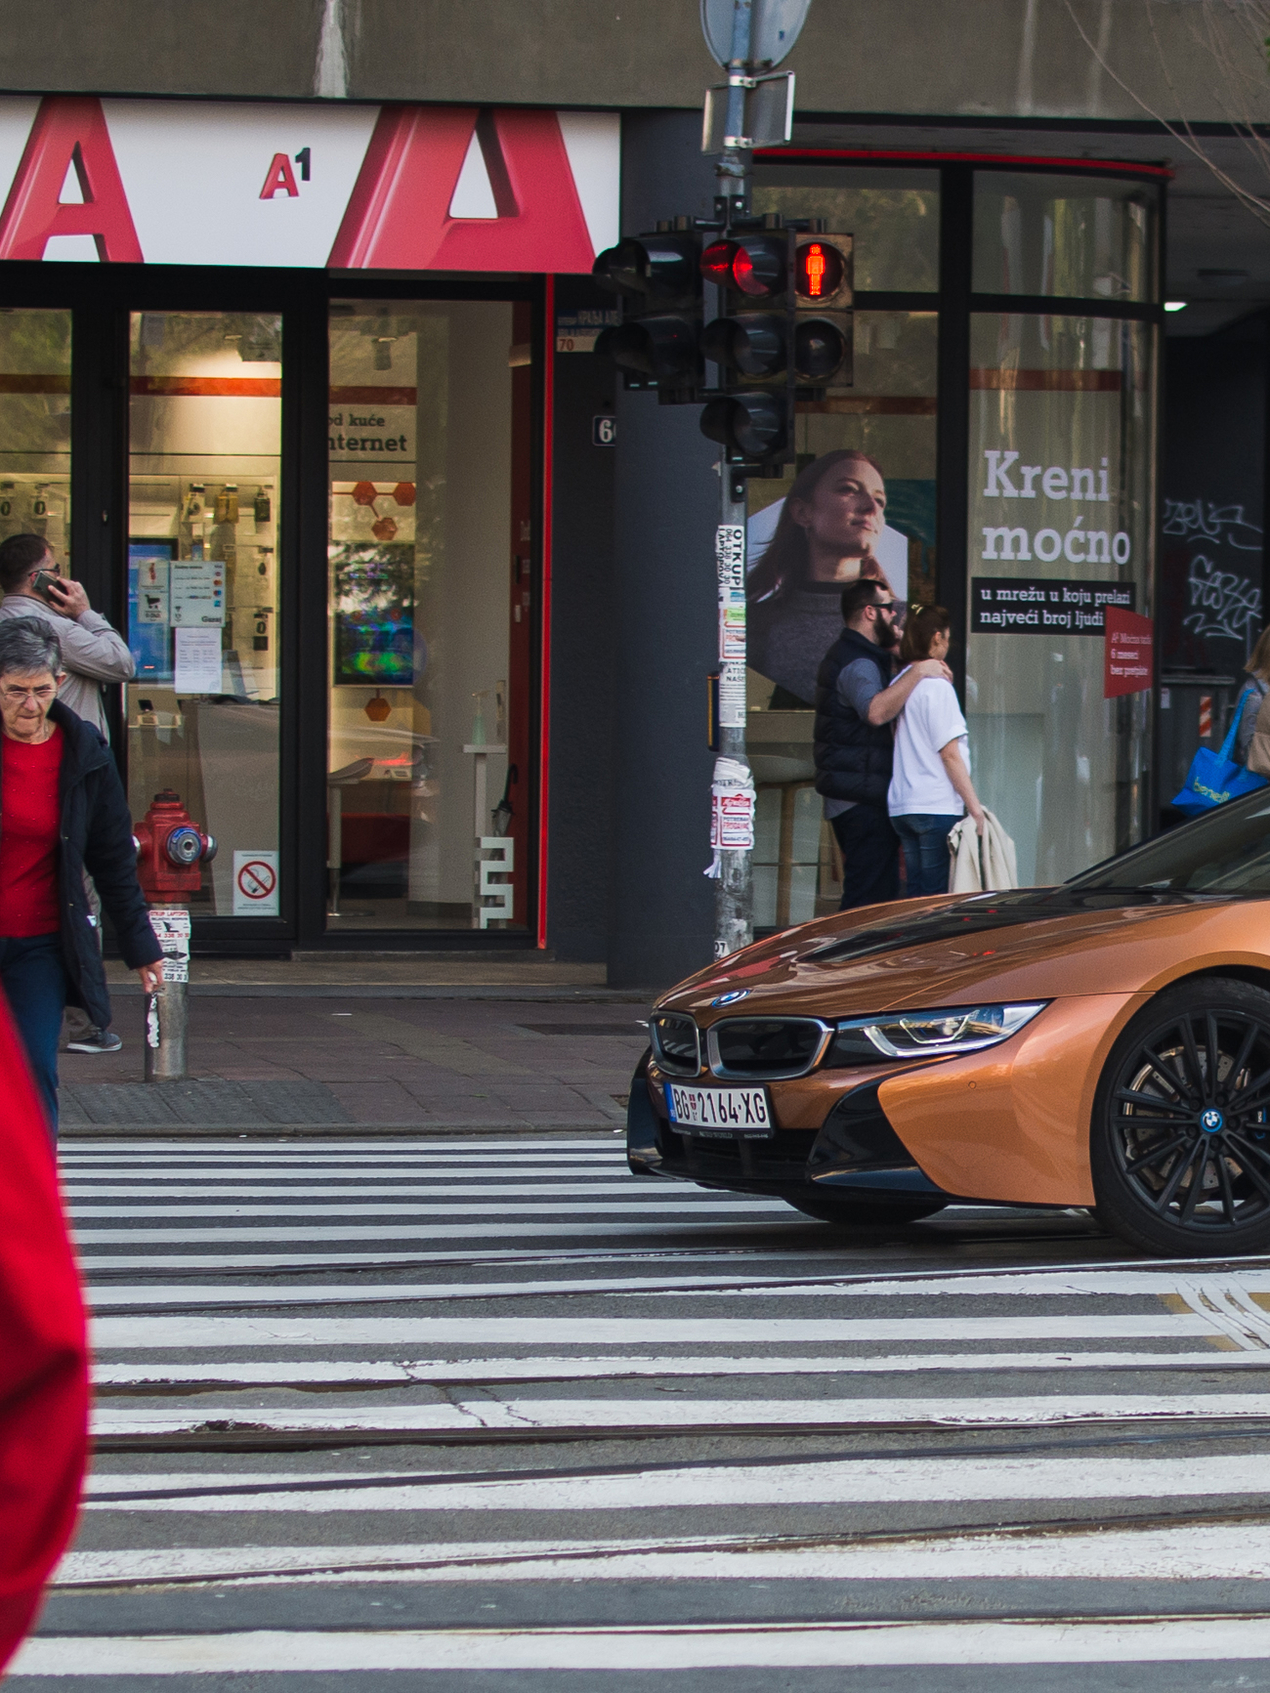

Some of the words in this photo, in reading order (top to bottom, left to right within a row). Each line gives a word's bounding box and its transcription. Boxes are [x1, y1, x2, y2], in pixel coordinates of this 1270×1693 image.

[259, 147, 311, 200] A1
[559, 339, 575, 351] 70
[348, 413, 385, 427] kuće
[329, 433, 407, 452] nternet
[983, 450, 1110, 502] Kreni
[981, 516, 1131, 565] moćno
[732, 529, 743, 586] OTKUP
[980, 588, 992, 600] u
[996, 586, 1046, 602] mrežu
[1049, 590, 1059, 602] u
[1063, 587, 1092, 607] koju
[1094, 589, 1131, 607] prelazi
[980, 609, 1039, 628] najveći
[1043, 609, 1071, 629] broj
[1075, 610, 1104, 629] ljudi
[673, 1088, 690, 1120] BG
